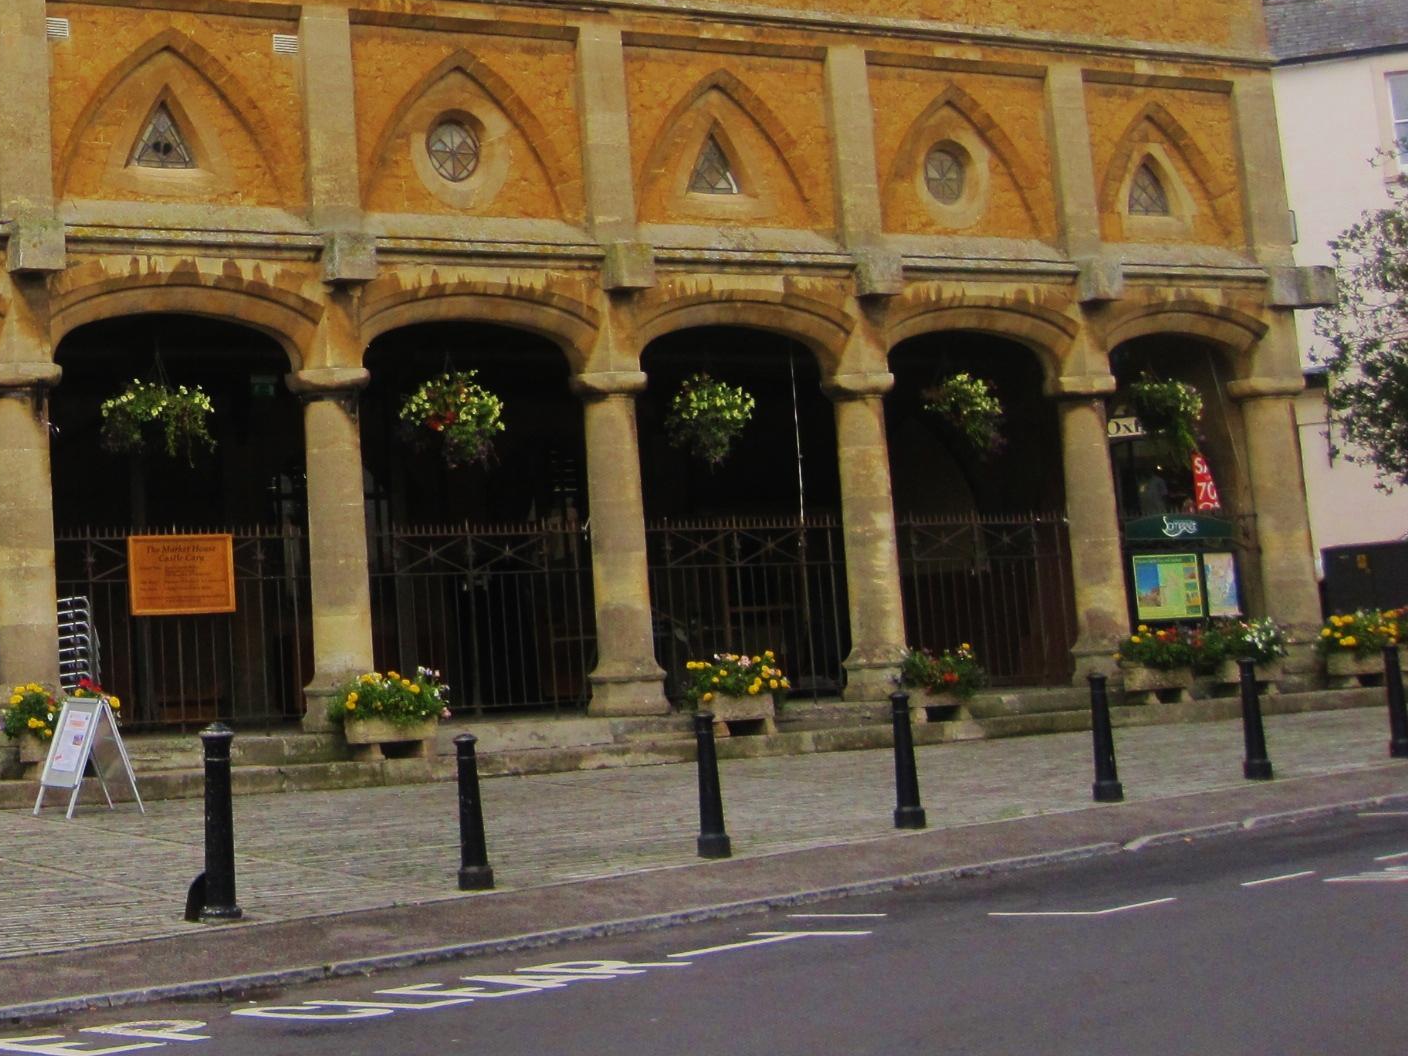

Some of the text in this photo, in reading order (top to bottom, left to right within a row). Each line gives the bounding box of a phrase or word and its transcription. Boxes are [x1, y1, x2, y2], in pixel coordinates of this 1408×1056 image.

[147, 544, 216, 553] The Market House
[158, 554, 205, 563] Castle Cary
